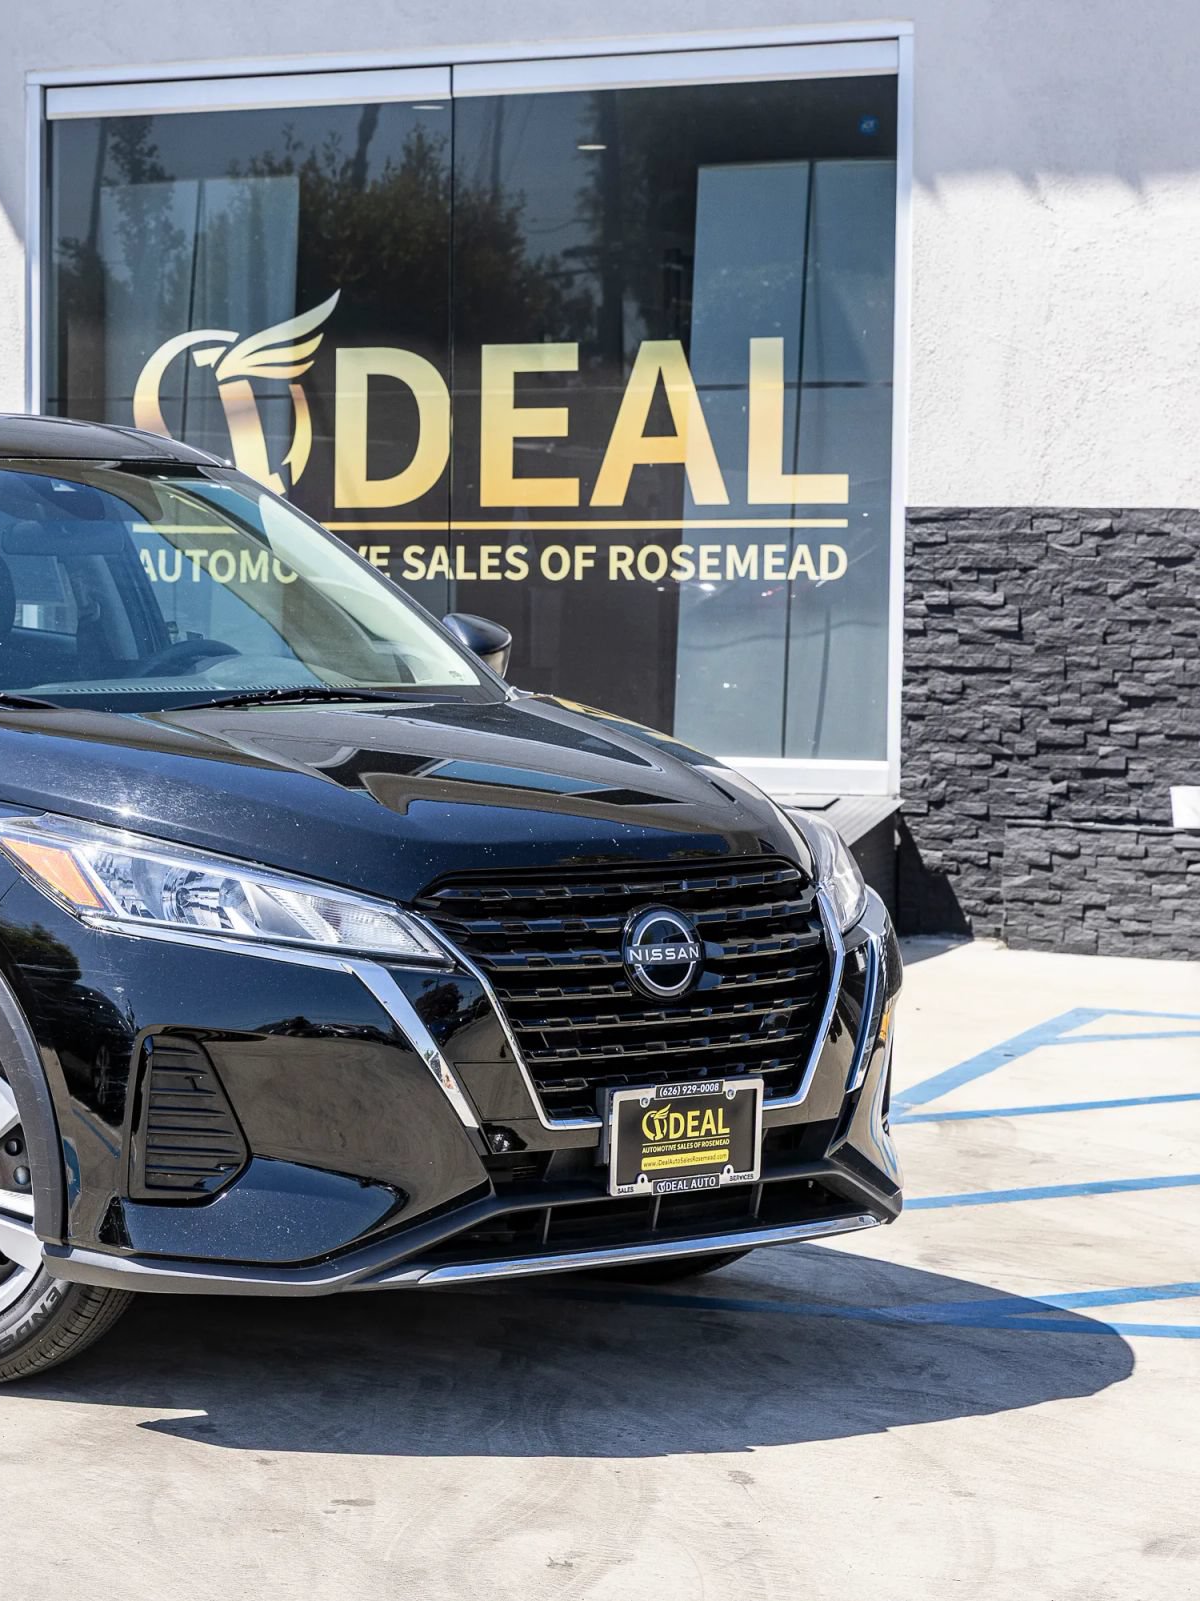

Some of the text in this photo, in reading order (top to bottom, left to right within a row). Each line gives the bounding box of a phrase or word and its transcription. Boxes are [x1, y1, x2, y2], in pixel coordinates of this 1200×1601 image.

[402, 545, 530, 582] SALES
[539, 544, 597, 581] OF
[608, 543, 848, 581] ROSEMEAD
[629, 946, 700, 962] NISSAN
[659, 1082, 720, 1098] (626) 929-0008
[641, 1138, 731, 1154] AUTOMOTIVE SALES OF ROSEMEAD
[690, 1176, 717, 1189] AUTO
[729, 1174, 754, 1182] SERVICES
[617, 1186, 634, 1194] SALES
